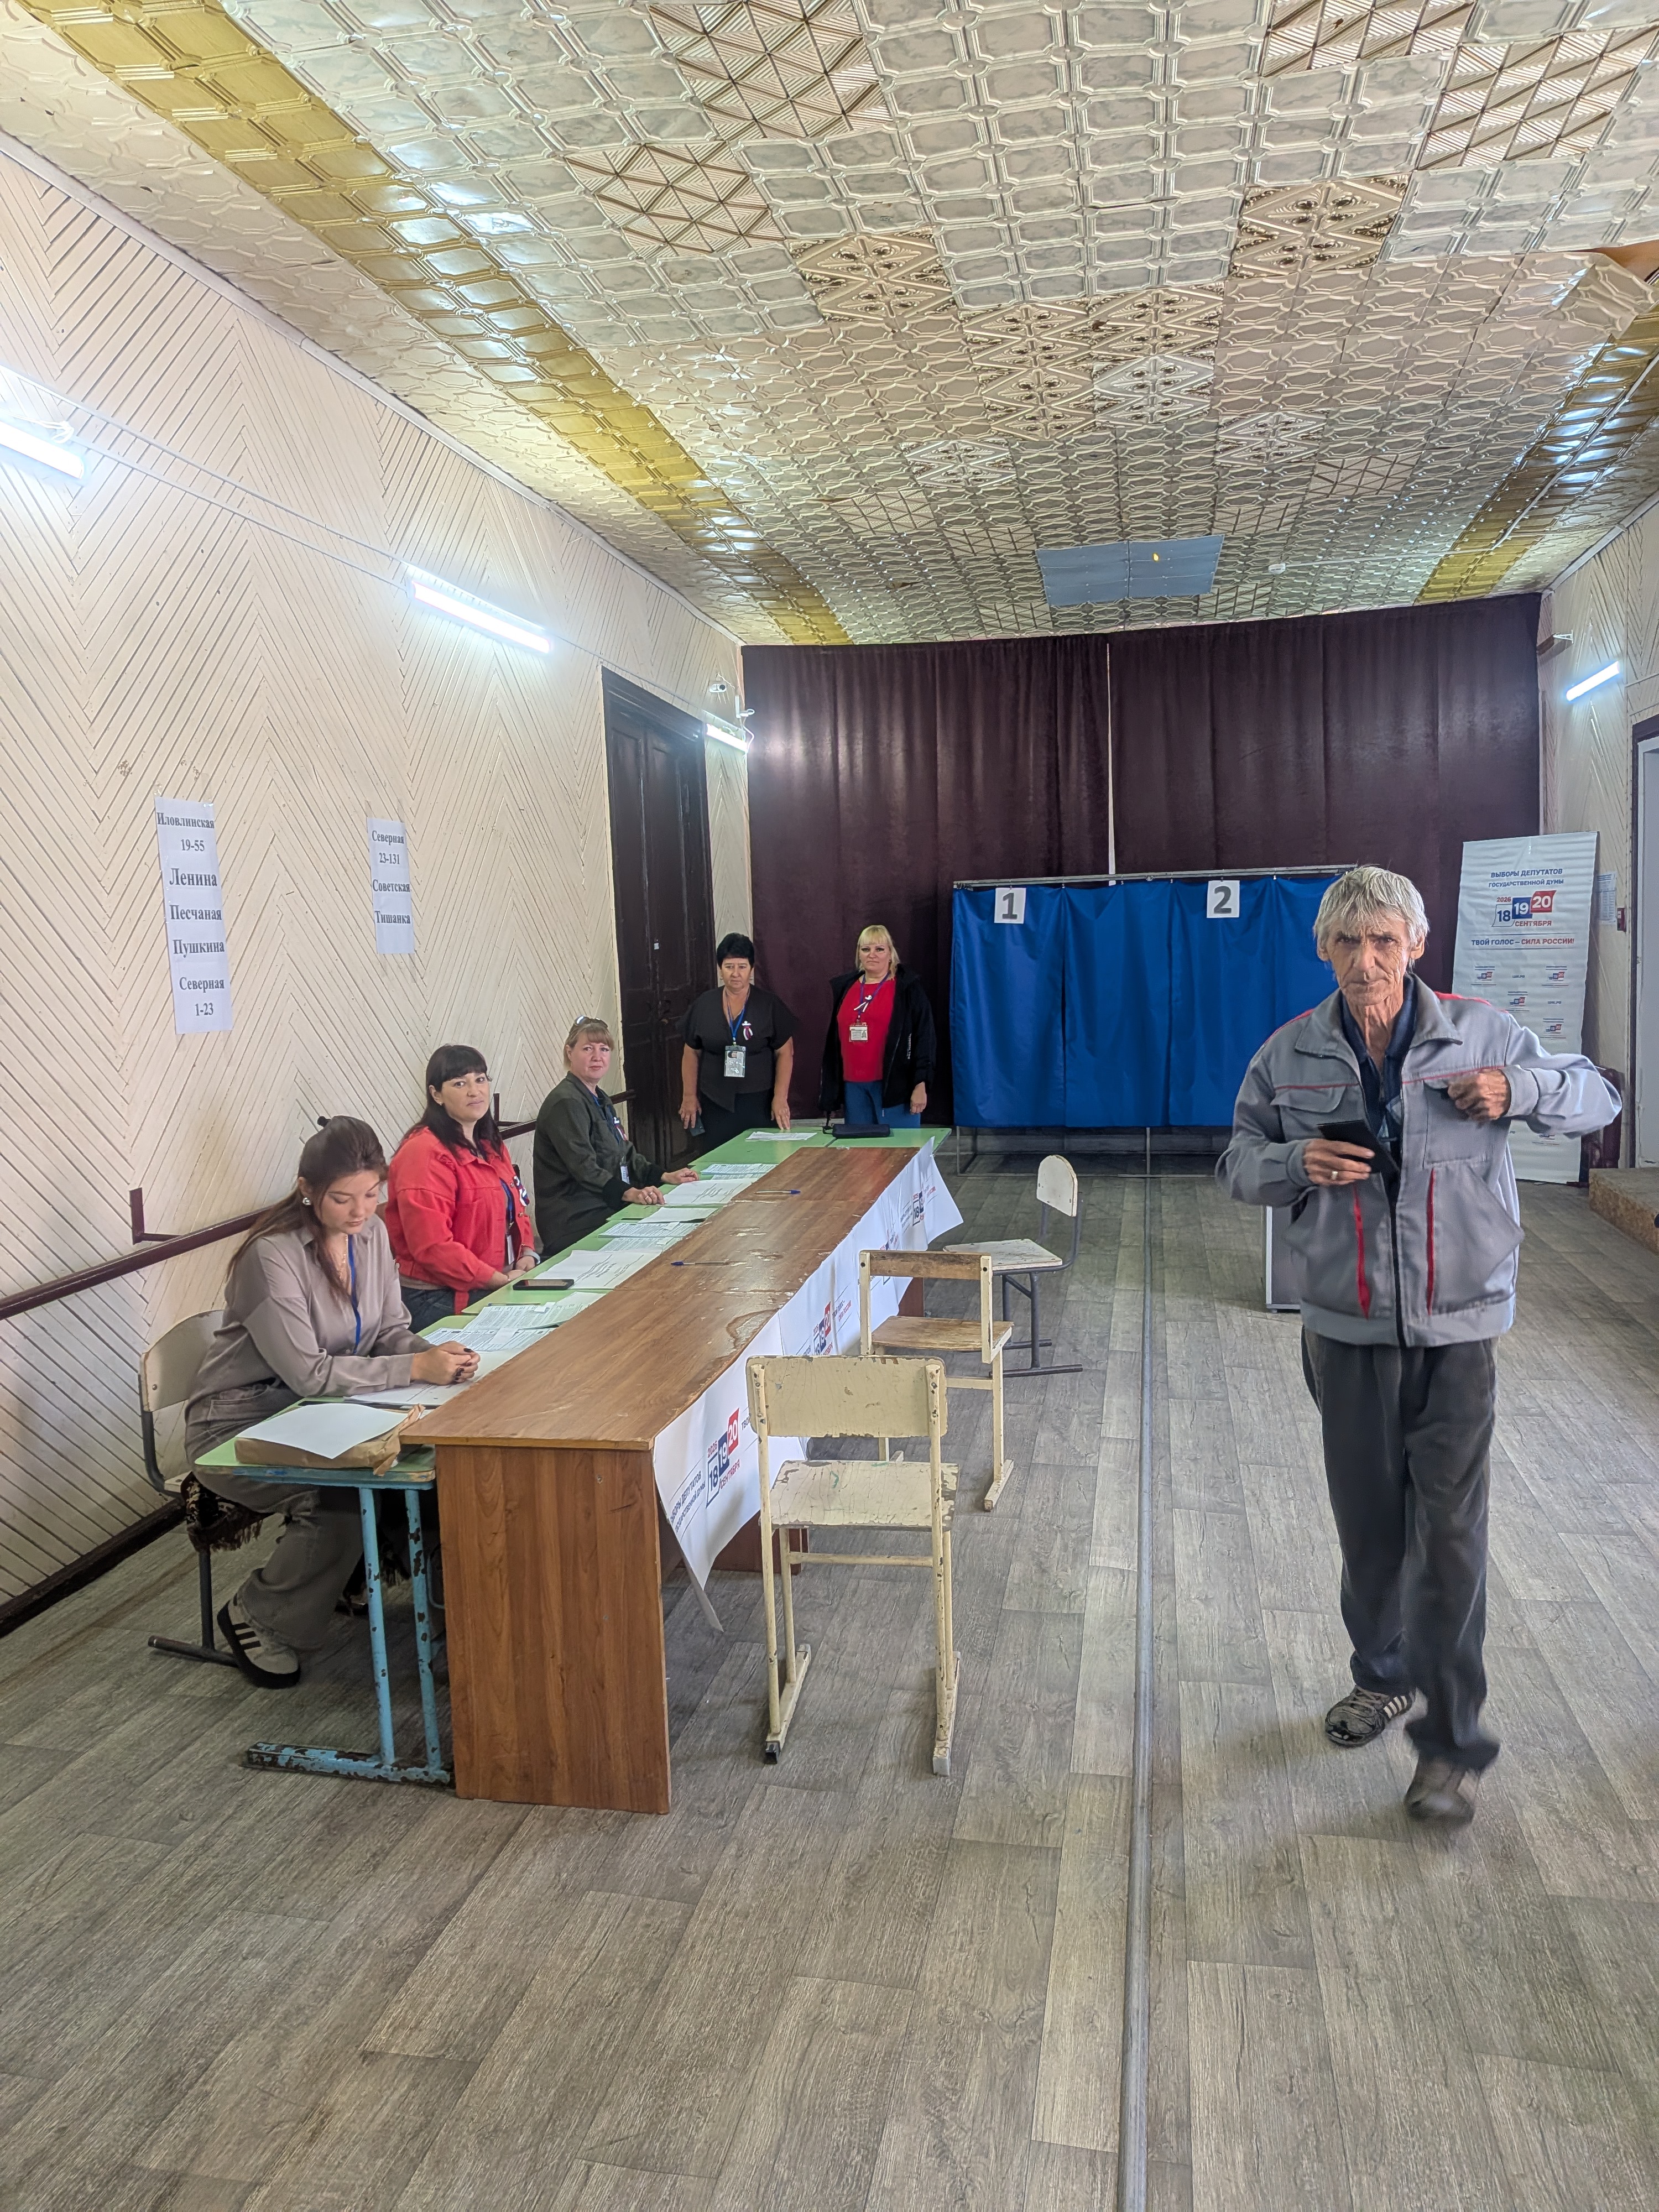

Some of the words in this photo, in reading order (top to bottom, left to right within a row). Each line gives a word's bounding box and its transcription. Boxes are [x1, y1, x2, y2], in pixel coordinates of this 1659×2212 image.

[157, 812, 215, 828] Иловлинская
[181, 839, 205, 852] 19-55
[372, 830, 404, 846] Северная
[379, 852, 400, 864] 23-131
[169, 868, 217, 886] Ленина
[1521, 868, 1563, 877] ДЕПУТАТОВ
[372, 879, 410, 892] Советская
[1488, 879, 1545, 888] ГОСУДАРСТВЕННОЙ
[1001, 892, 1018, 920] 1
[1213, 885, 1232, 914] 2
[169, 905, 222, 920] Песчаная
[374, 910, 411, 924] Тишанка
[1497, 910, 1511, 922] 18
[1514, 902, 1529, 915] 19
[1532, 896, 1551, 909] 20
[173, 939, 225, 958] Пушкина
[179, 977, 225, 993] Северная
[195, 1002, 214, 1016] 1-23
[709, 1465, 718, 1492] 18
[719, 1442, 728, 1469] 19
[728, 1419, 738, 1448] 20
[721, 1458, 740, 1490] СЕНТЯБРЯ
